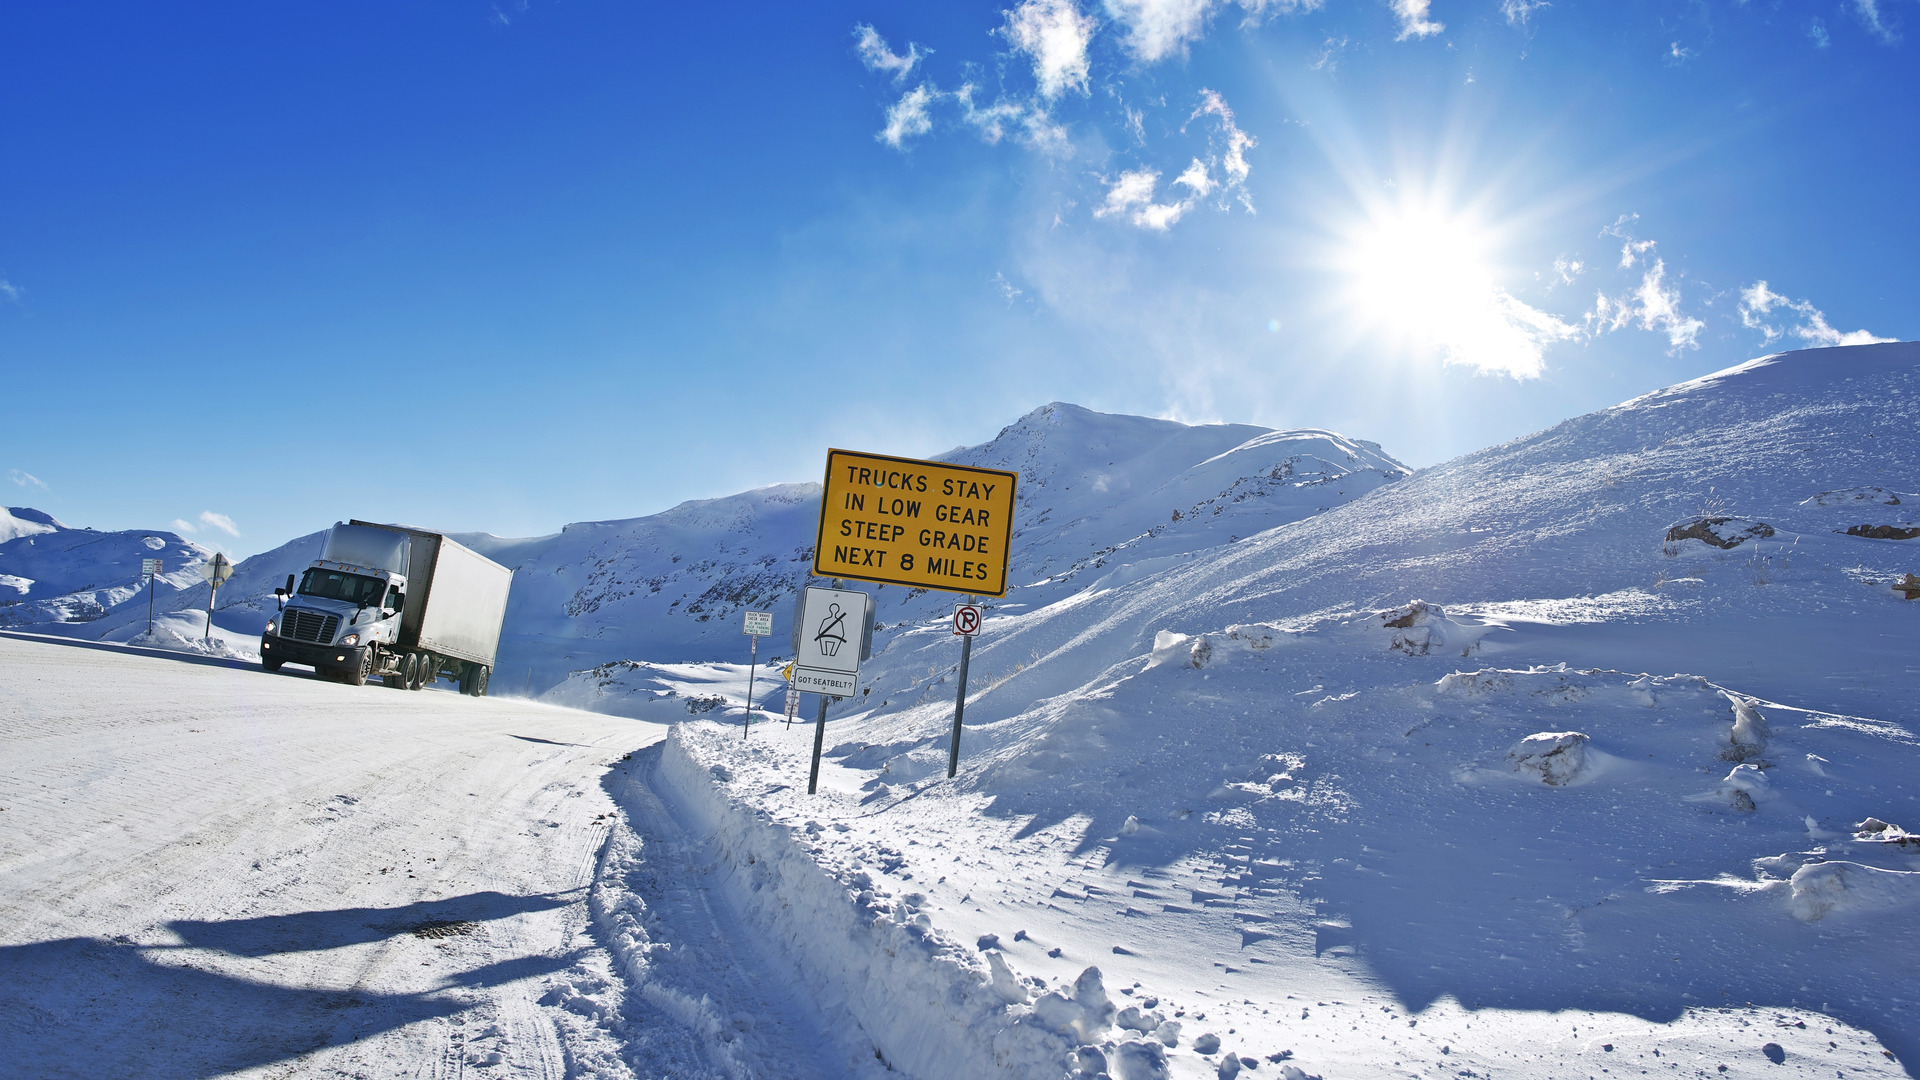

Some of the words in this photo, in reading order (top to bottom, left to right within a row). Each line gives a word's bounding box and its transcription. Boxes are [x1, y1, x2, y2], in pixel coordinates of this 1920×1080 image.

[847, 466, 927, 492] TRUCKS
[942, 478, 995, 500] STAY
[845, 493, 865, 511] IN
[878, 497, 921, 518] LOW
[935, 504, 990, 527] GEAR
[840, 519, 905, 542] STEEP
[919, 529, 989, 554] GRADE
[834, 545, 887, 568] NEXT
[900, 553, 914, 571] 8
[927, 557, 988, 580] MILES
[962, 611, 975, 628] P
[798, 676, 811, 684] GOT
[813, 678, 853, 689] SEATBELT?
